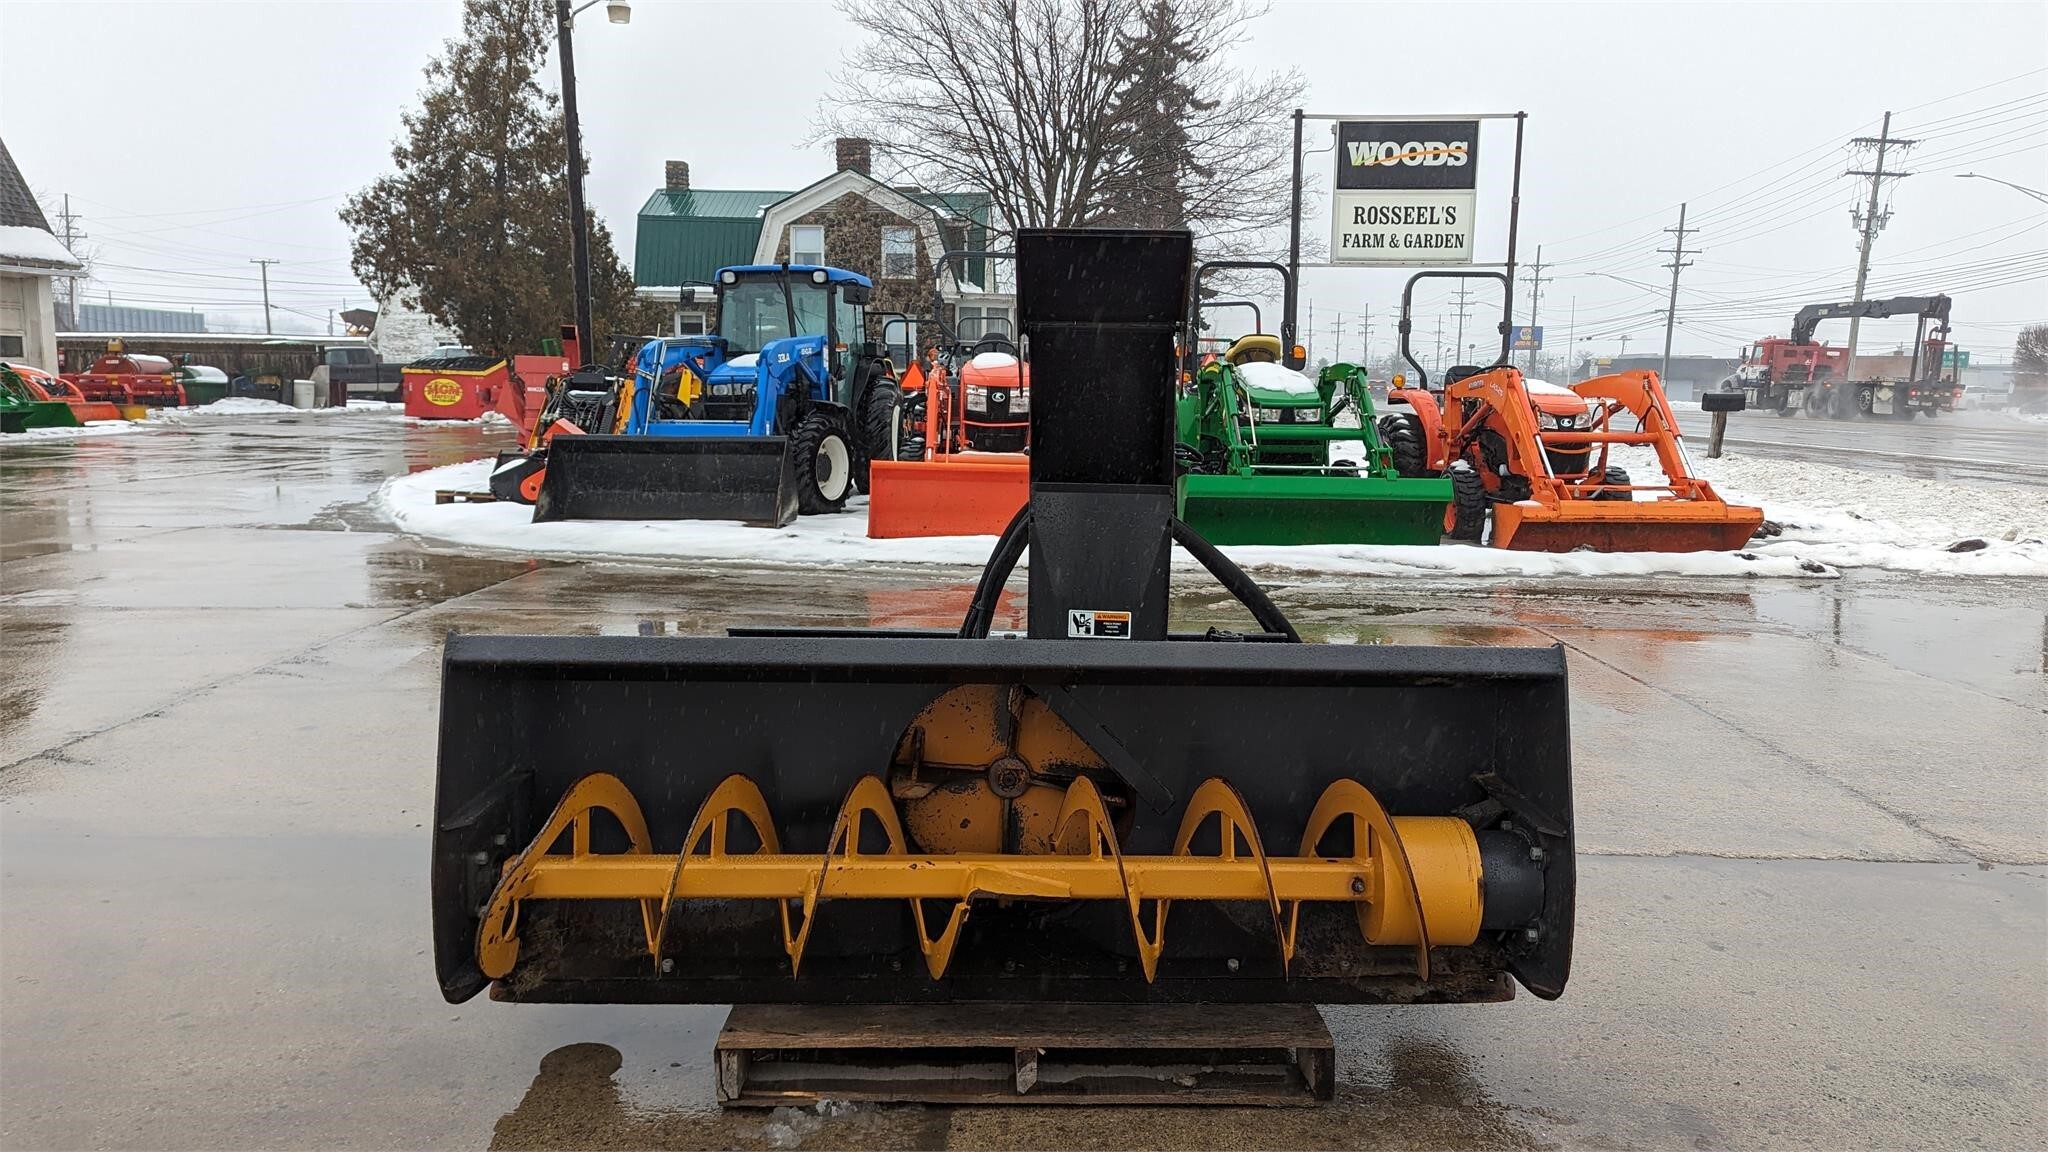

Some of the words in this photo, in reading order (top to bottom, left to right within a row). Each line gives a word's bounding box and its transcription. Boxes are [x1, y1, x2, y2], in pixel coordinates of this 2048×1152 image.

[1347, 141, 1468, 167] WOODS
[1353, 206, 1457, 225] ROSSEEL'S
[1342, 233, 1385, 248] FARM
[1389, 233, 1400, 248] &
[1404, 233, 1465, 249] GARDEN
